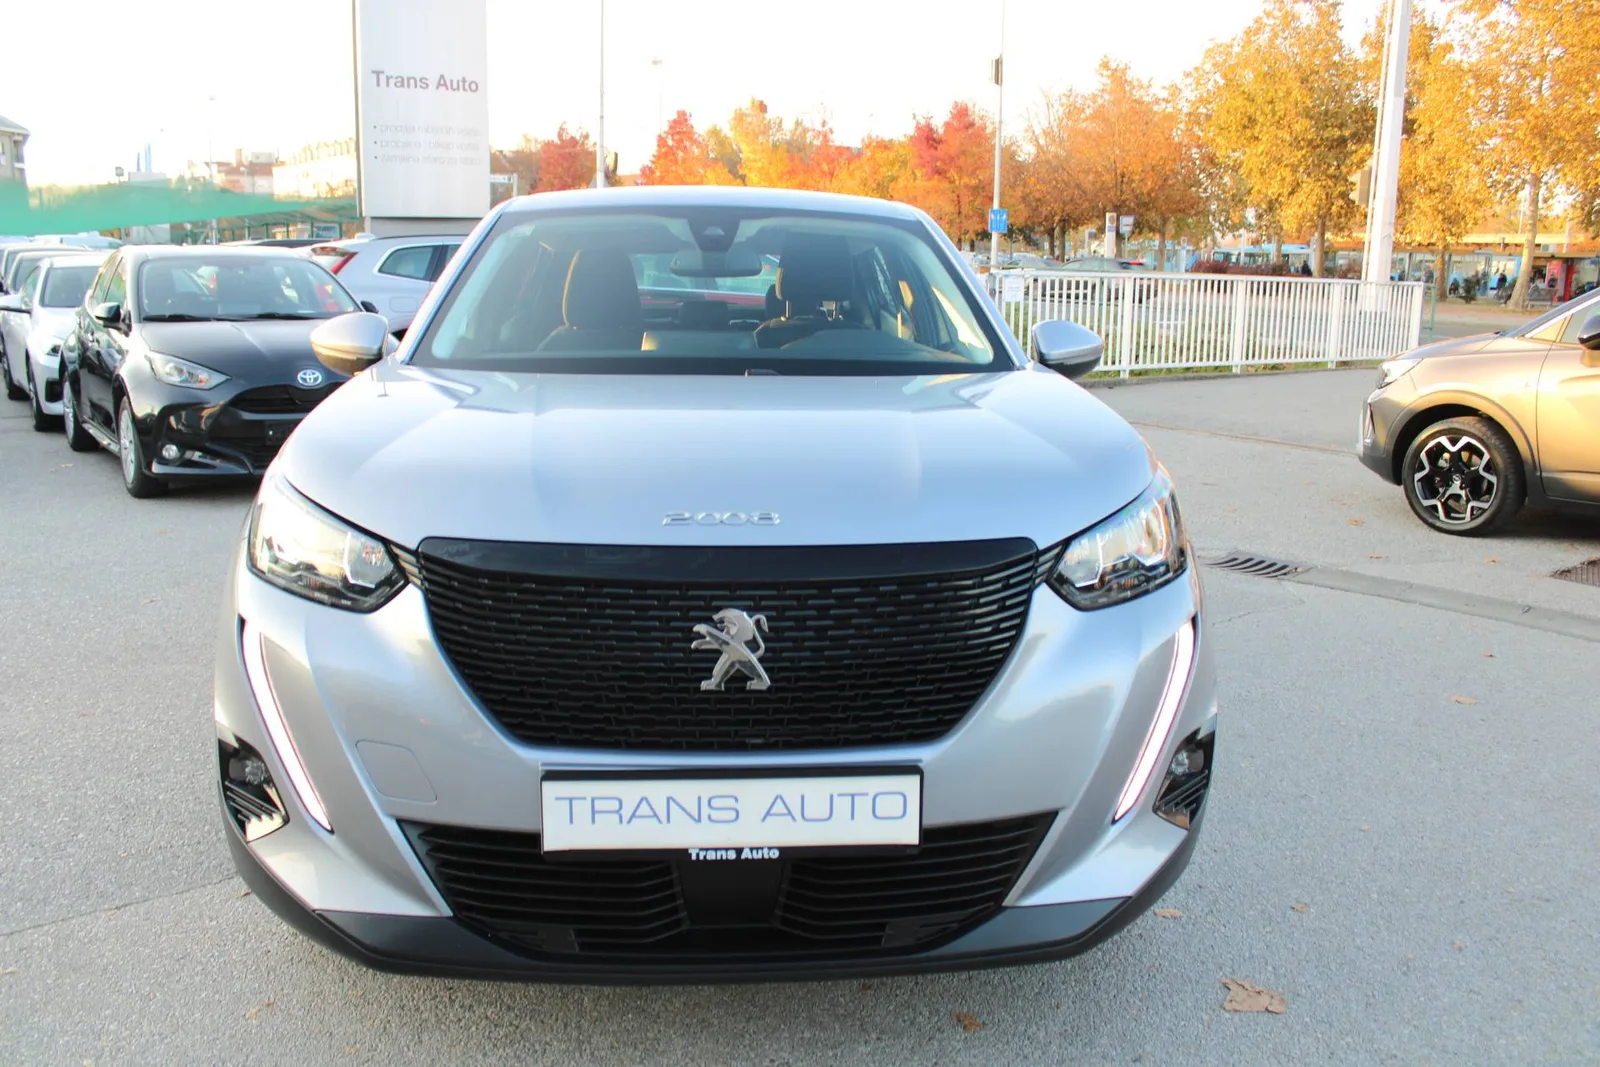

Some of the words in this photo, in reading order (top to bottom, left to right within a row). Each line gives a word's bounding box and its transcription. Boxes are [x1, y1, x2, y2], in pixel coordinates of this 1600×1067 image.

[371, 70, 430, 90] Trans
[436, 74, 479, 93] Auto
[662, 511, 781, 526] 2008
[554, 795, 740, 826] TRANS
[761, 791, 908, 823] AUTO
[688, 847, 737, 861] Trans
[740, 846, 780, 860] Auto
